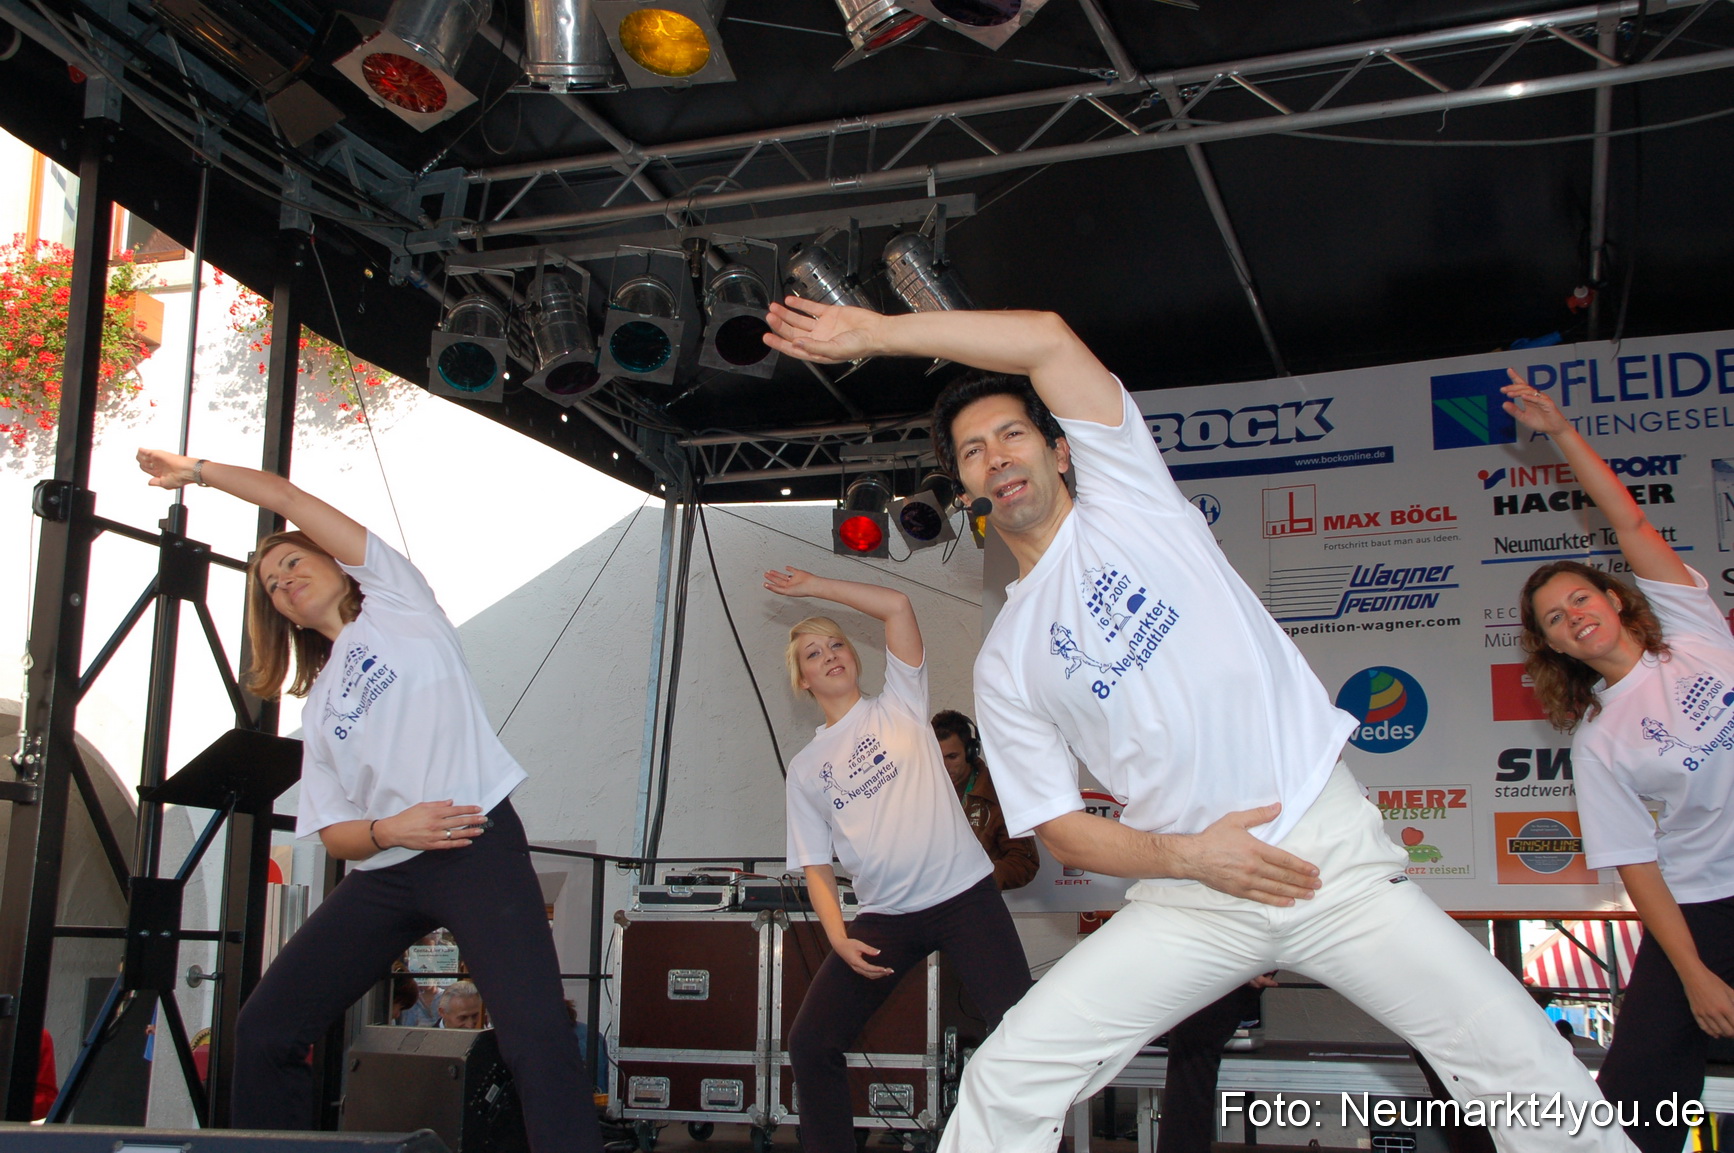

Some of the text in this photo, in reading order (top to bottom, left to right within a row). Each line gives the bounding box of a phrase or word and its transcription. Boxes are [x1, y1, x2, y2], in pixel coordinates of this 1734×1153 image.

[1143, 397, 1335, 453] BOCK
[1295, 450, 1386, 467] www.bockonline.de
[1510, 454, 1682, 488] INTEPORT
[1323, 504, 1458, 531] MAX BÖGL
[1324, 533, 1462, 551] Fortschritt baut man aus Ideen.
[1494, 531, 1597, 555] Neumarkter
[1350, 563, 1455, 591] Wagner
[1091, 599, 1167, 700] 8. Neumarkter
[334, 664, 389, 740] 8. Neumarkter
[848, 741, 881, 770] 16.09.2007
[1682, 757, 1705, 772] 8.
[833, 760, 895, 810] 8. Neumarkter
[864, 766, 899, 799] Stadtlauf
[1378, 789, 1467, 809] MERZ
[1512, 840, 1580, 851] FINISH LINE
[1429, 865, 1470, 875] reisen!
